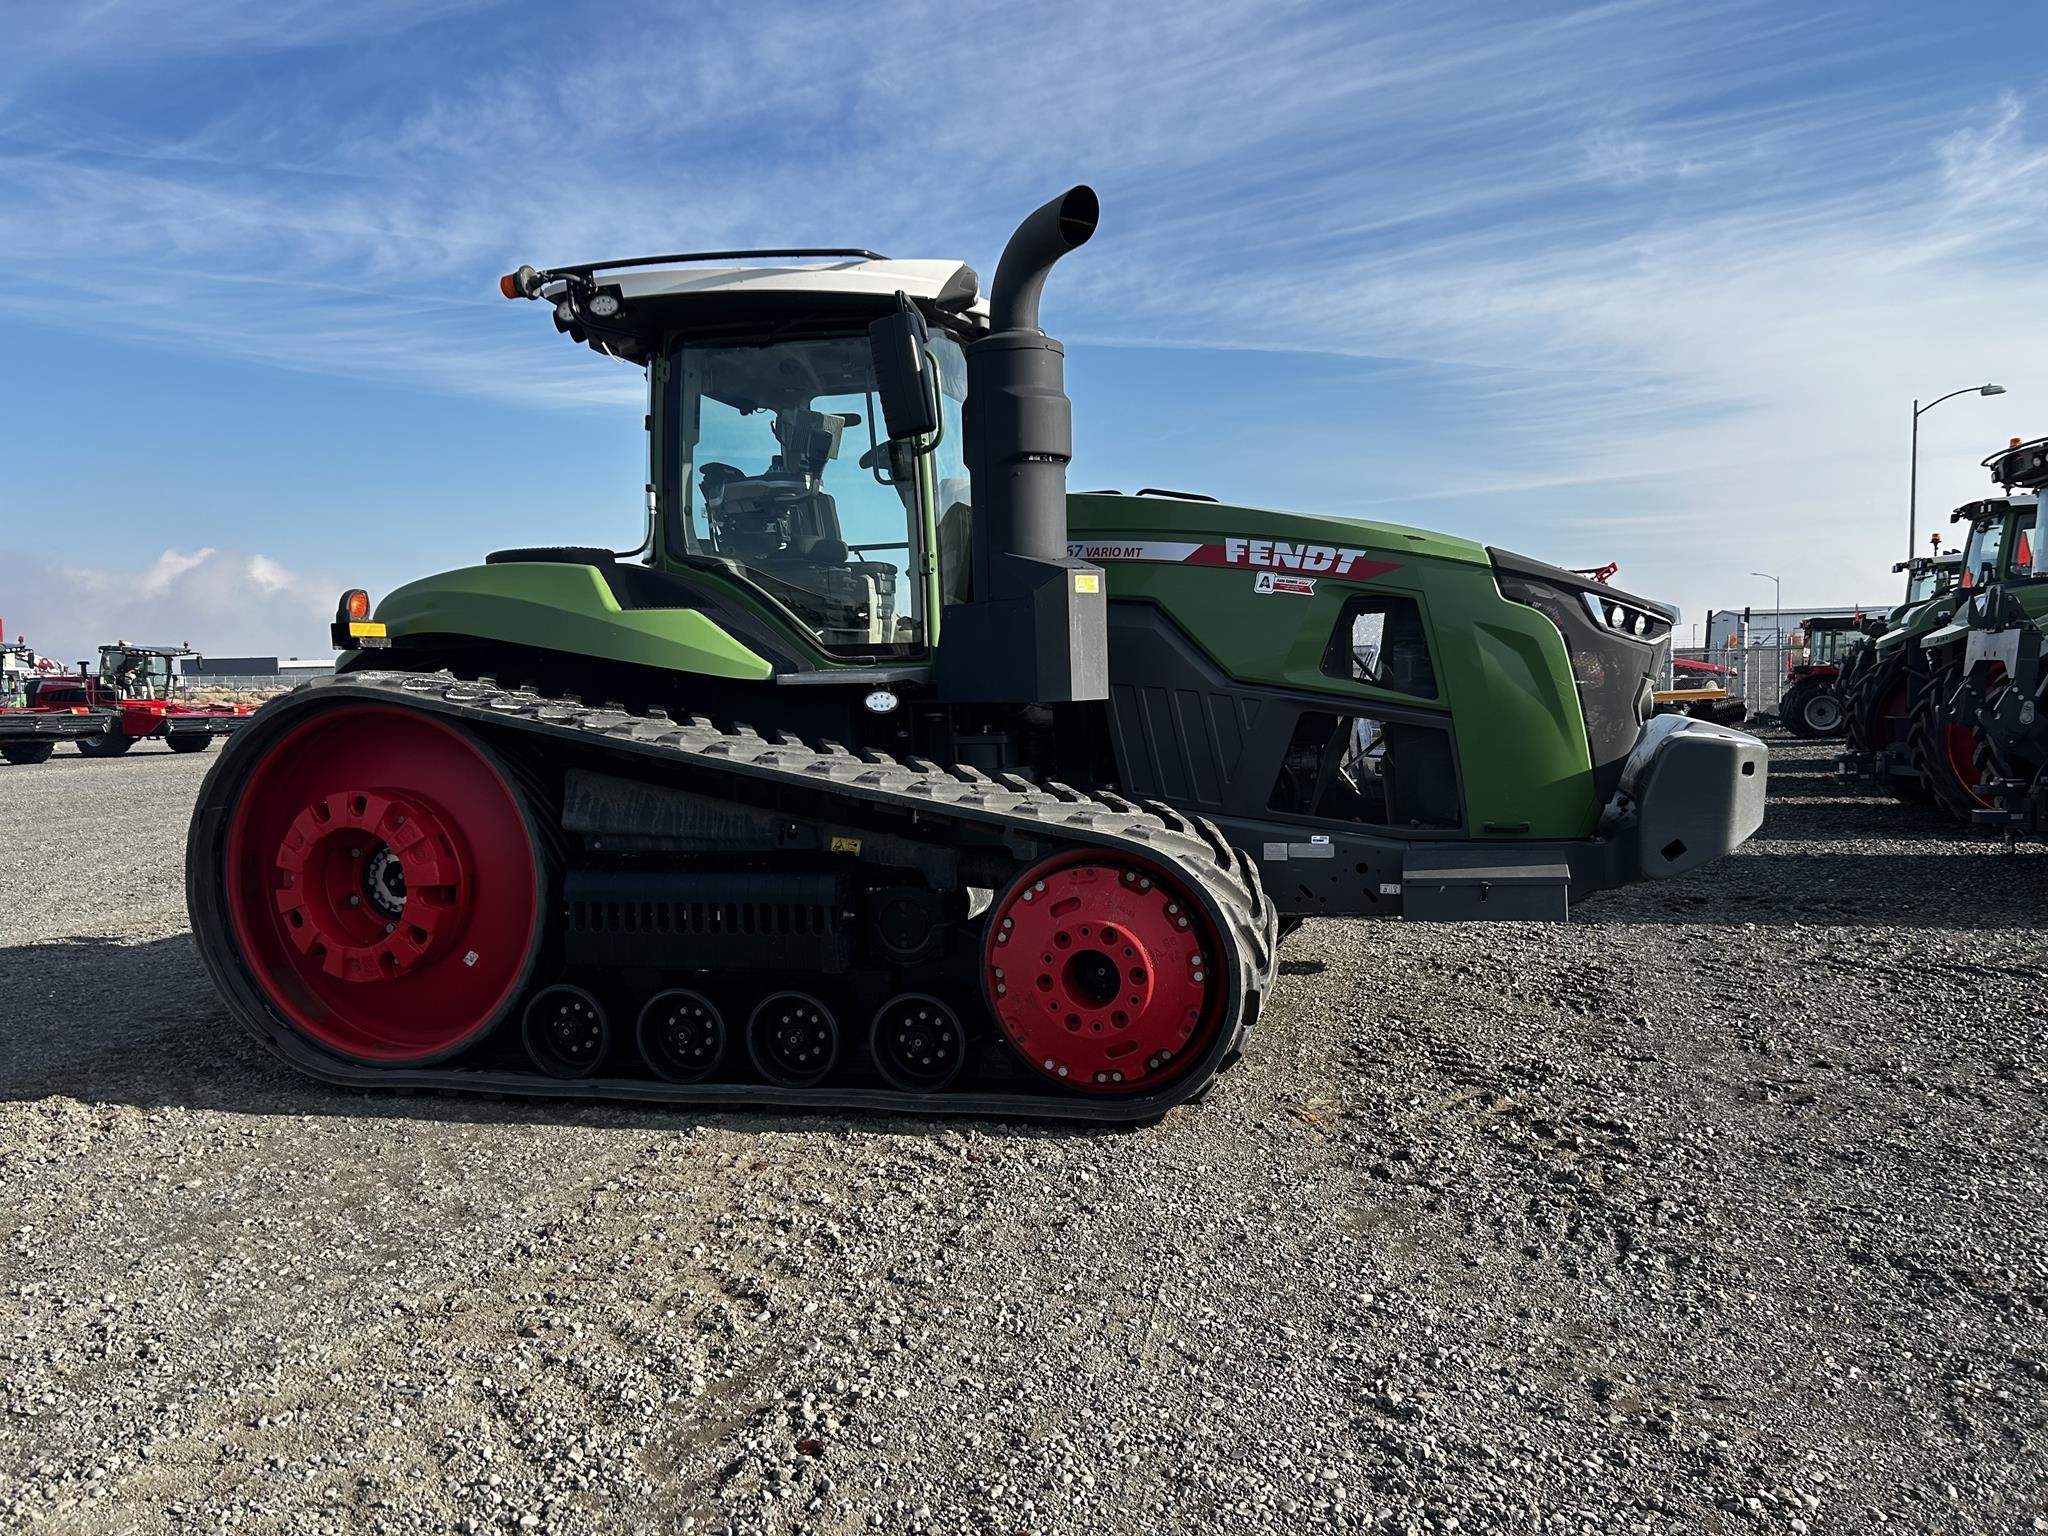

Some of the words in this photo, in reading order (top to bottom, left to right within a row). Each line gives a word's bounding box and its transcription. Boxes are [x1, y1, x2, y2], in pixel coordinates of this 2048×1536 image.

[1086, 547, 1122, 558] VARIO
[1123, 547, 1144, 558] MT
[1225, 537, 1367, 574] FENDT
